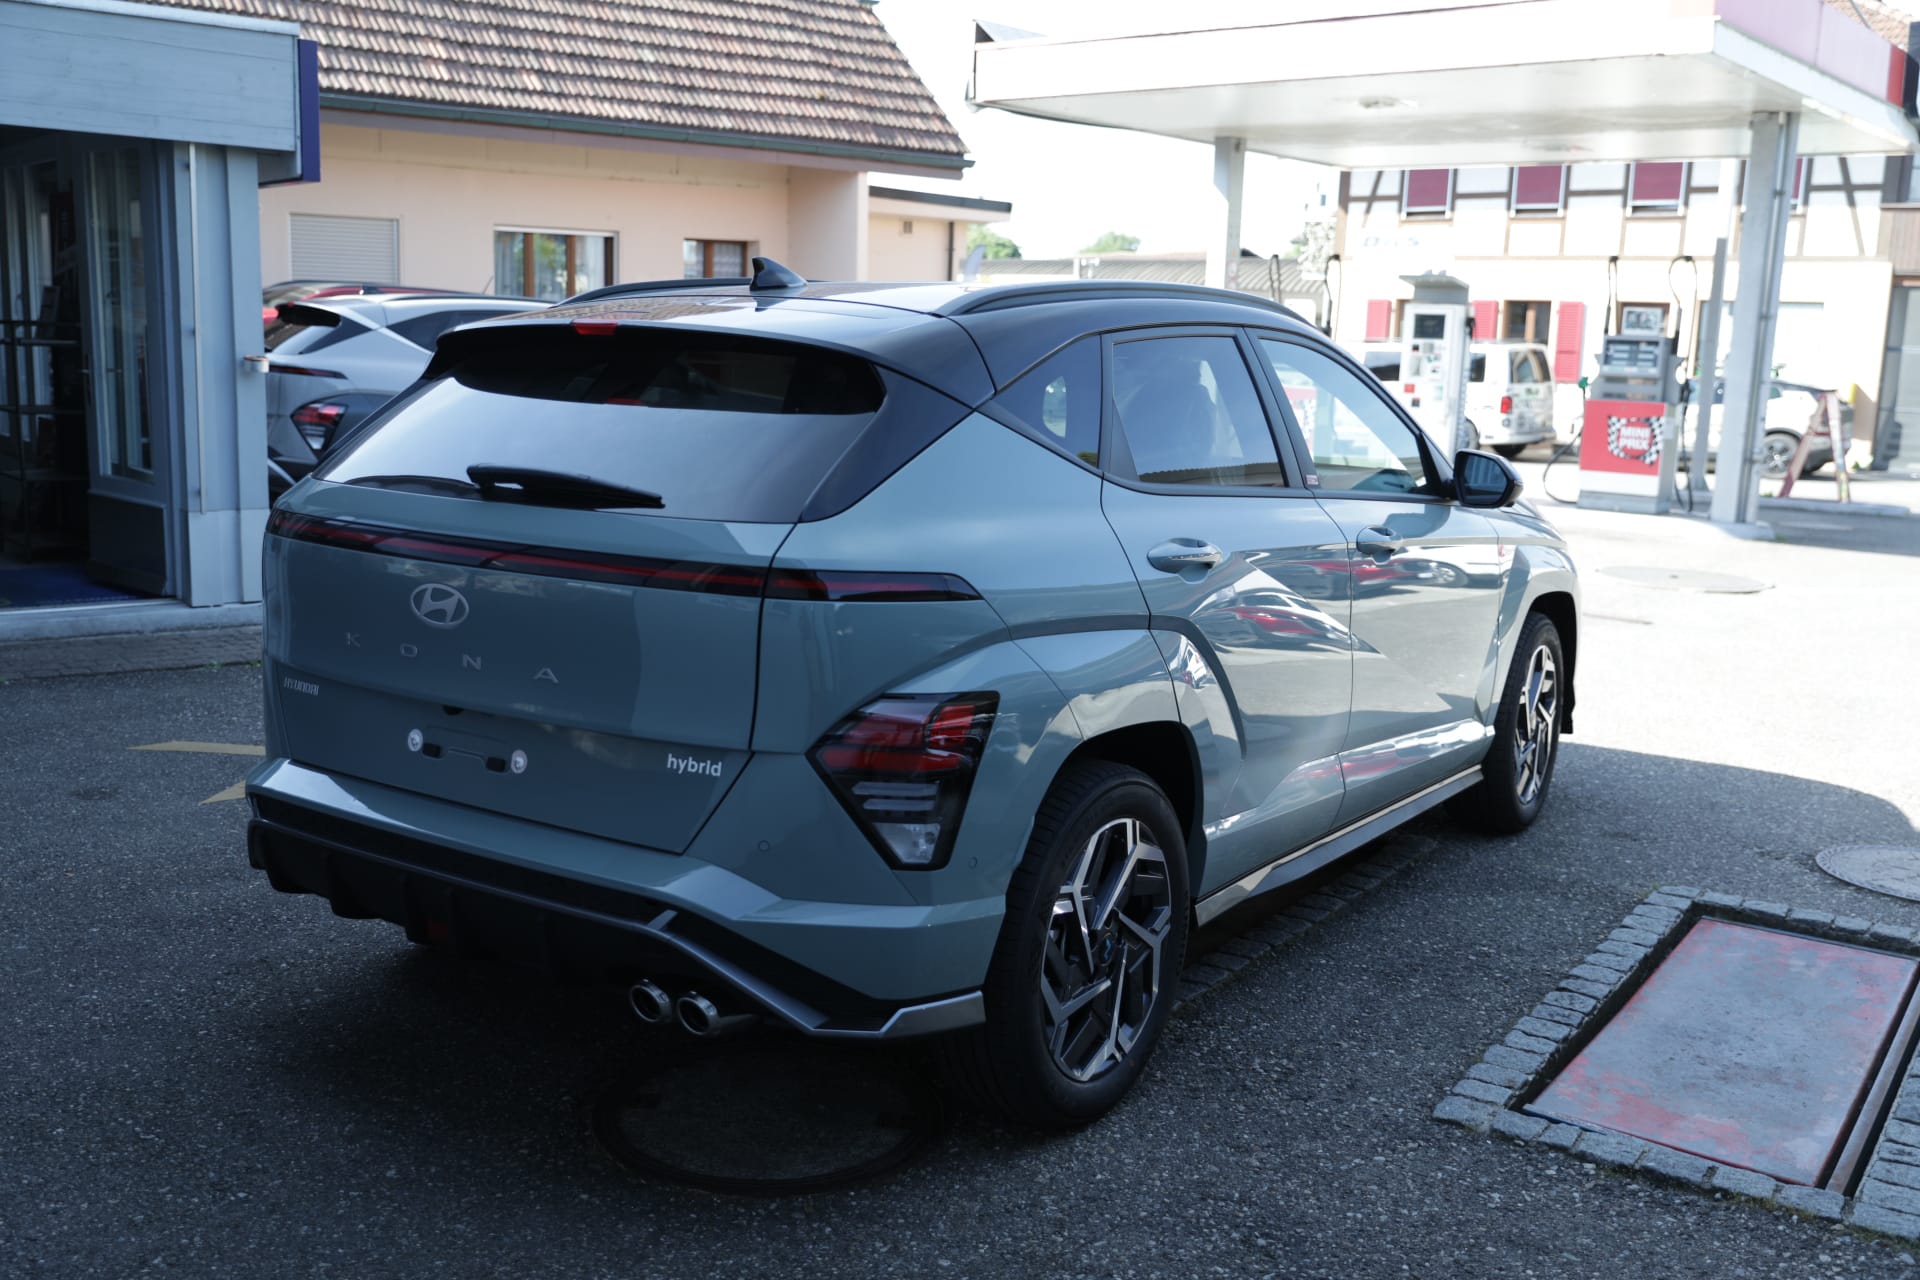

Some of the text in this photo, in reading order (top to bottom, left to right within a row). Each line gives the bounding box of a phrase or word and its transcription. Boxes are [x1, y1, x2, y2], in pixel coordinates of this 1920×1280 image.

[1620, 426, 1650, 438] MINI
[1618, 437, 1649, 450] PRIX
[345, 631, 559, 684] KONA
[283, 676, 320, 697] HYUNDAI
[666, 752, 723, 777] hybrid
